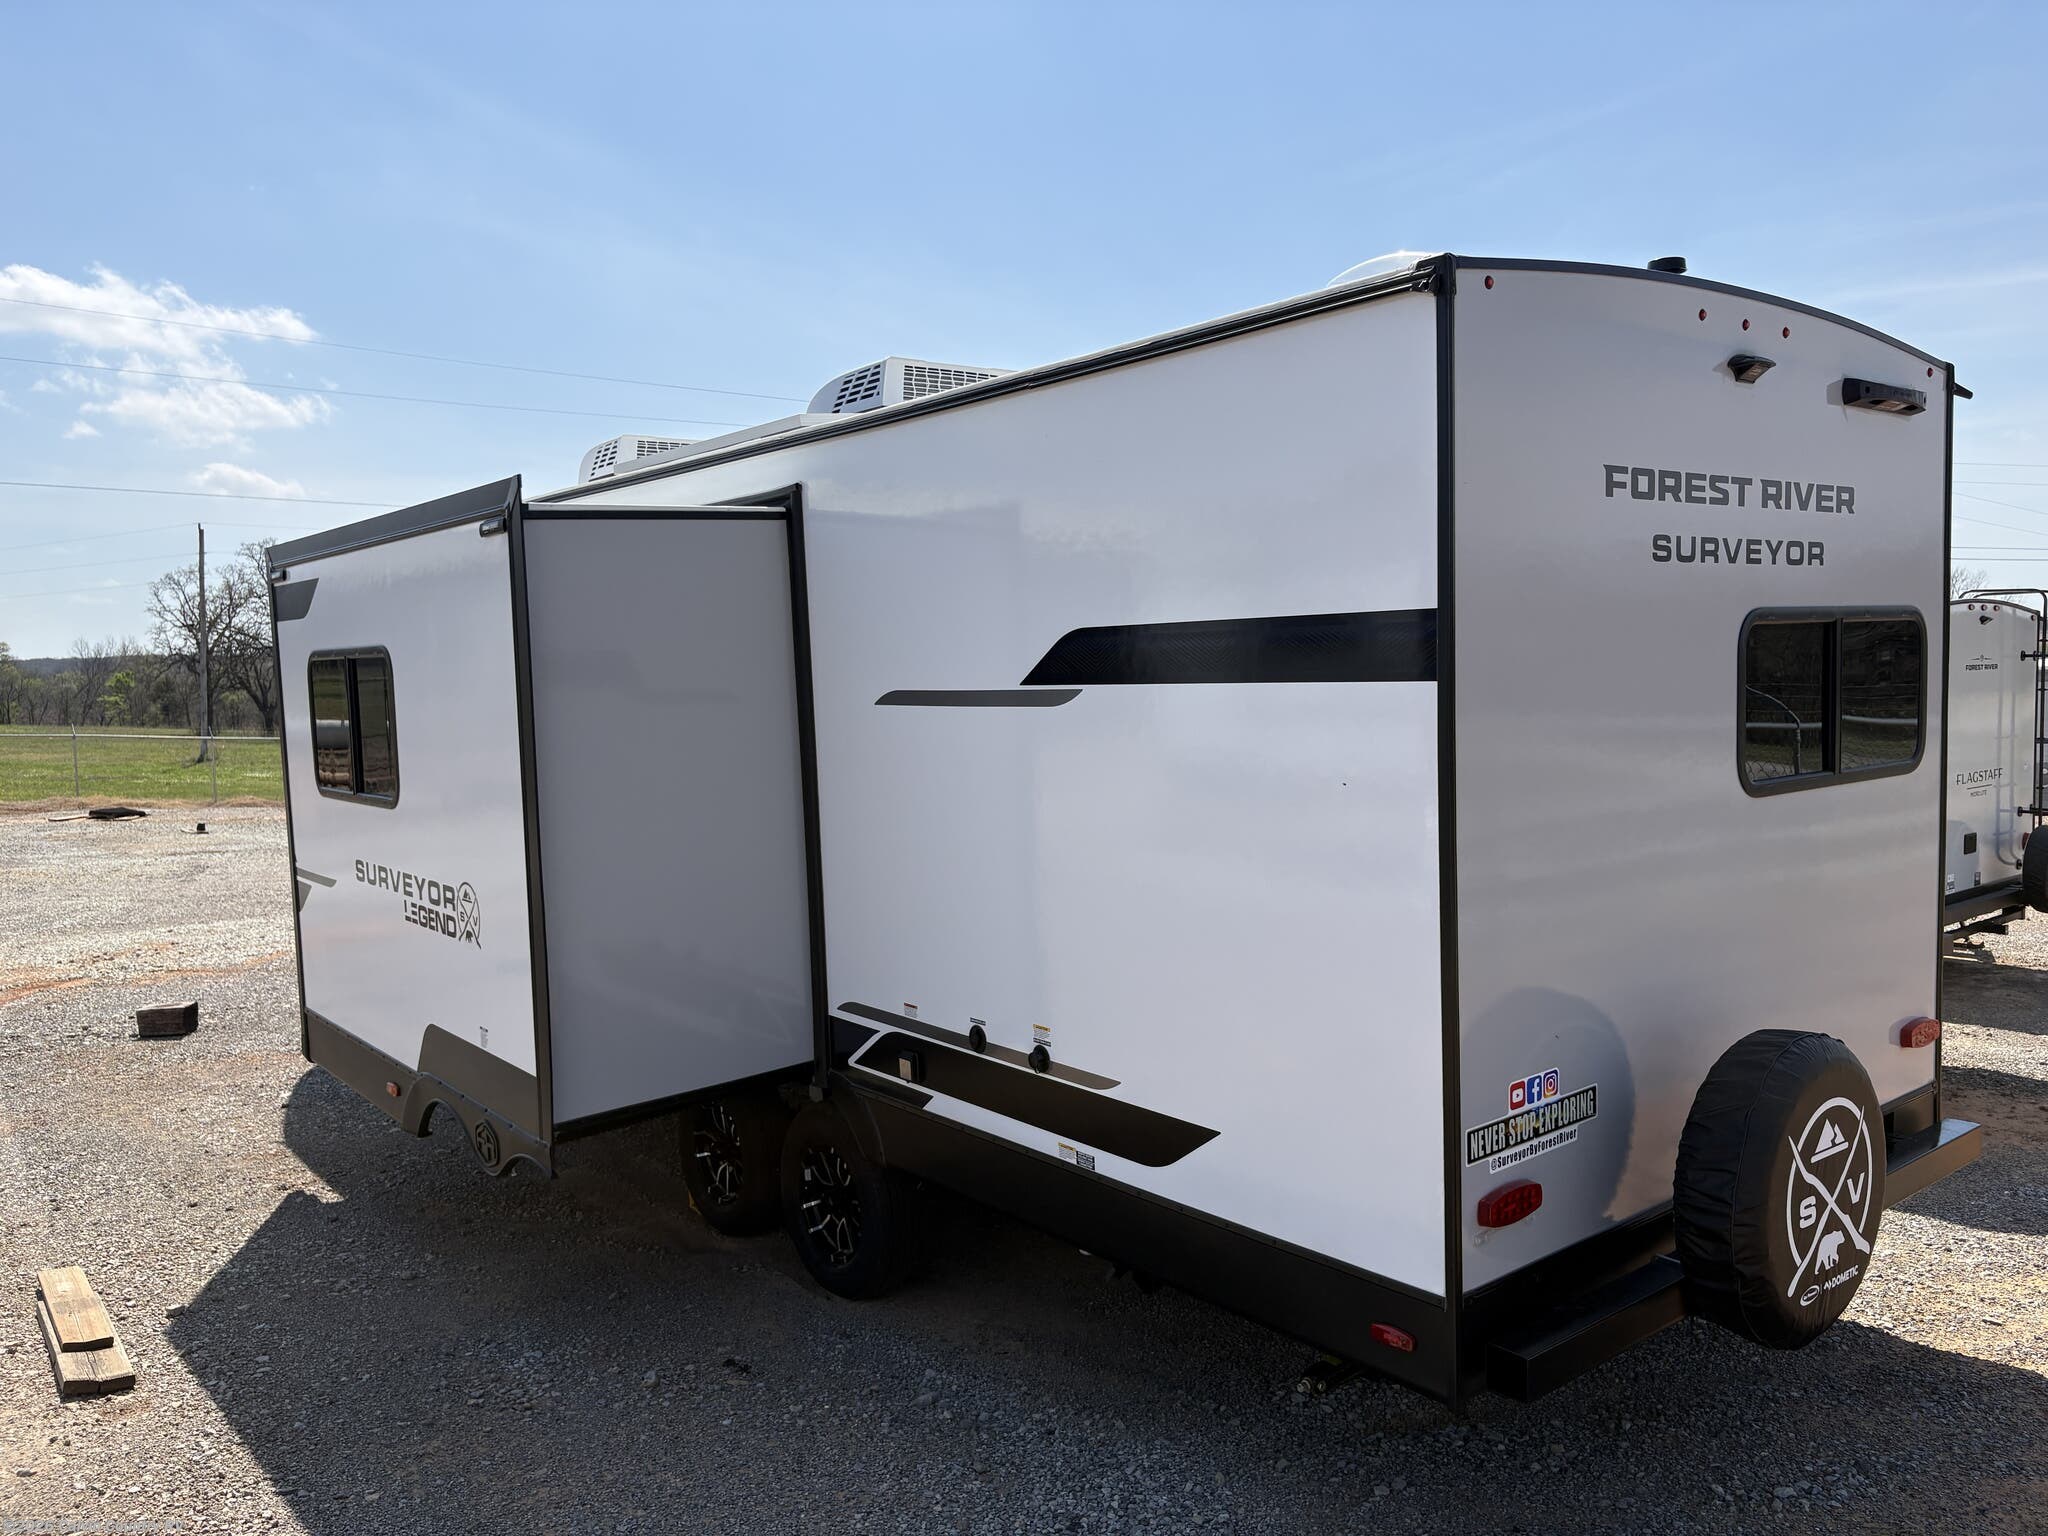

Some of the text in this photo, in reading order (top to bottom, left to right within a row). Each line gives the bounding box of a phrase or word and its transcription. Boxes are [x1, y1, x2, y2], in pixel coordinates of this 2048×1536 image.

[1603, 464, 1855, 514] FOREST RIVER
[1652, 534, 1825, 566] SURVEYOR
[1956, 768, 2003, 785] FLAGSTAFF
[355, 859, 456, 911] SURVEYOR
[404, 899, 457, 938] LEGEND
[1470, 1089, 1594, 1160] NEVER STOP EXPLORING
[1490, 1128, 1577, 1170] @SurveyorByForestRiver
[1800, 1171, 1865, 1229] S V
[1831, 1264, 1859, 1288] DOMETIC
